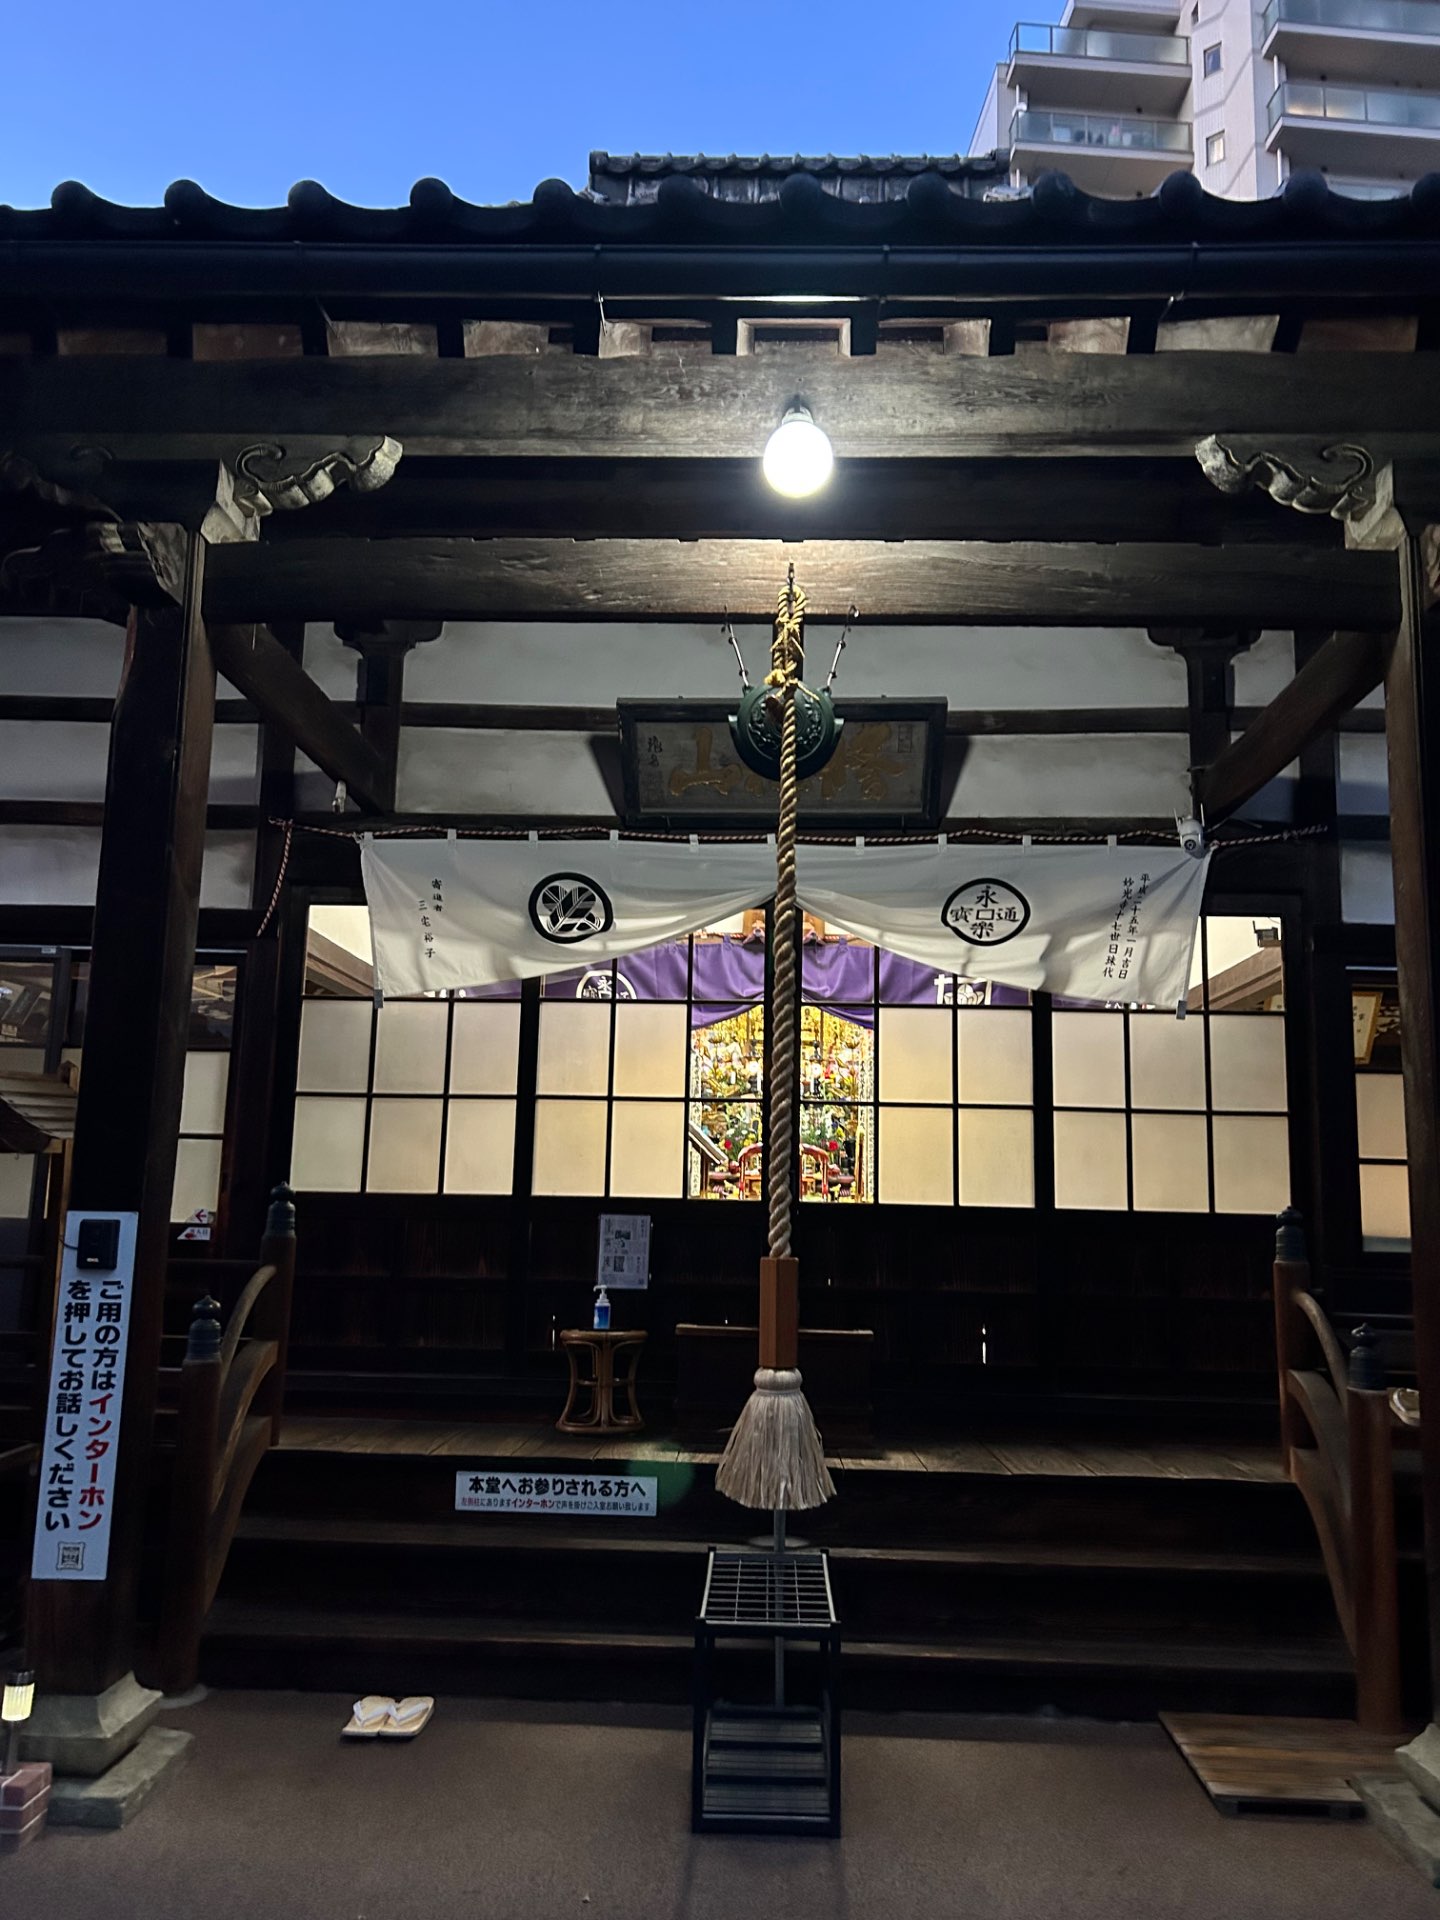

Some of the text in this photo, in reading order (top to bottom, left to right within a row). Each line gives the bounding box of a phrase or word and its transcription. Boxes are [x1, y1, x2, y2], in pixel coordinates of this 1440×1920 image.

[1118, 873, 1150, 979] 平成二十五年一月吉日
[45, 1280, 93, 1531] を押してお話しください
[79, 1280, 123, 1531] ご用の方はインターホン
[469, 1476, 647, 1497] 本堂へお参りされる方へ
